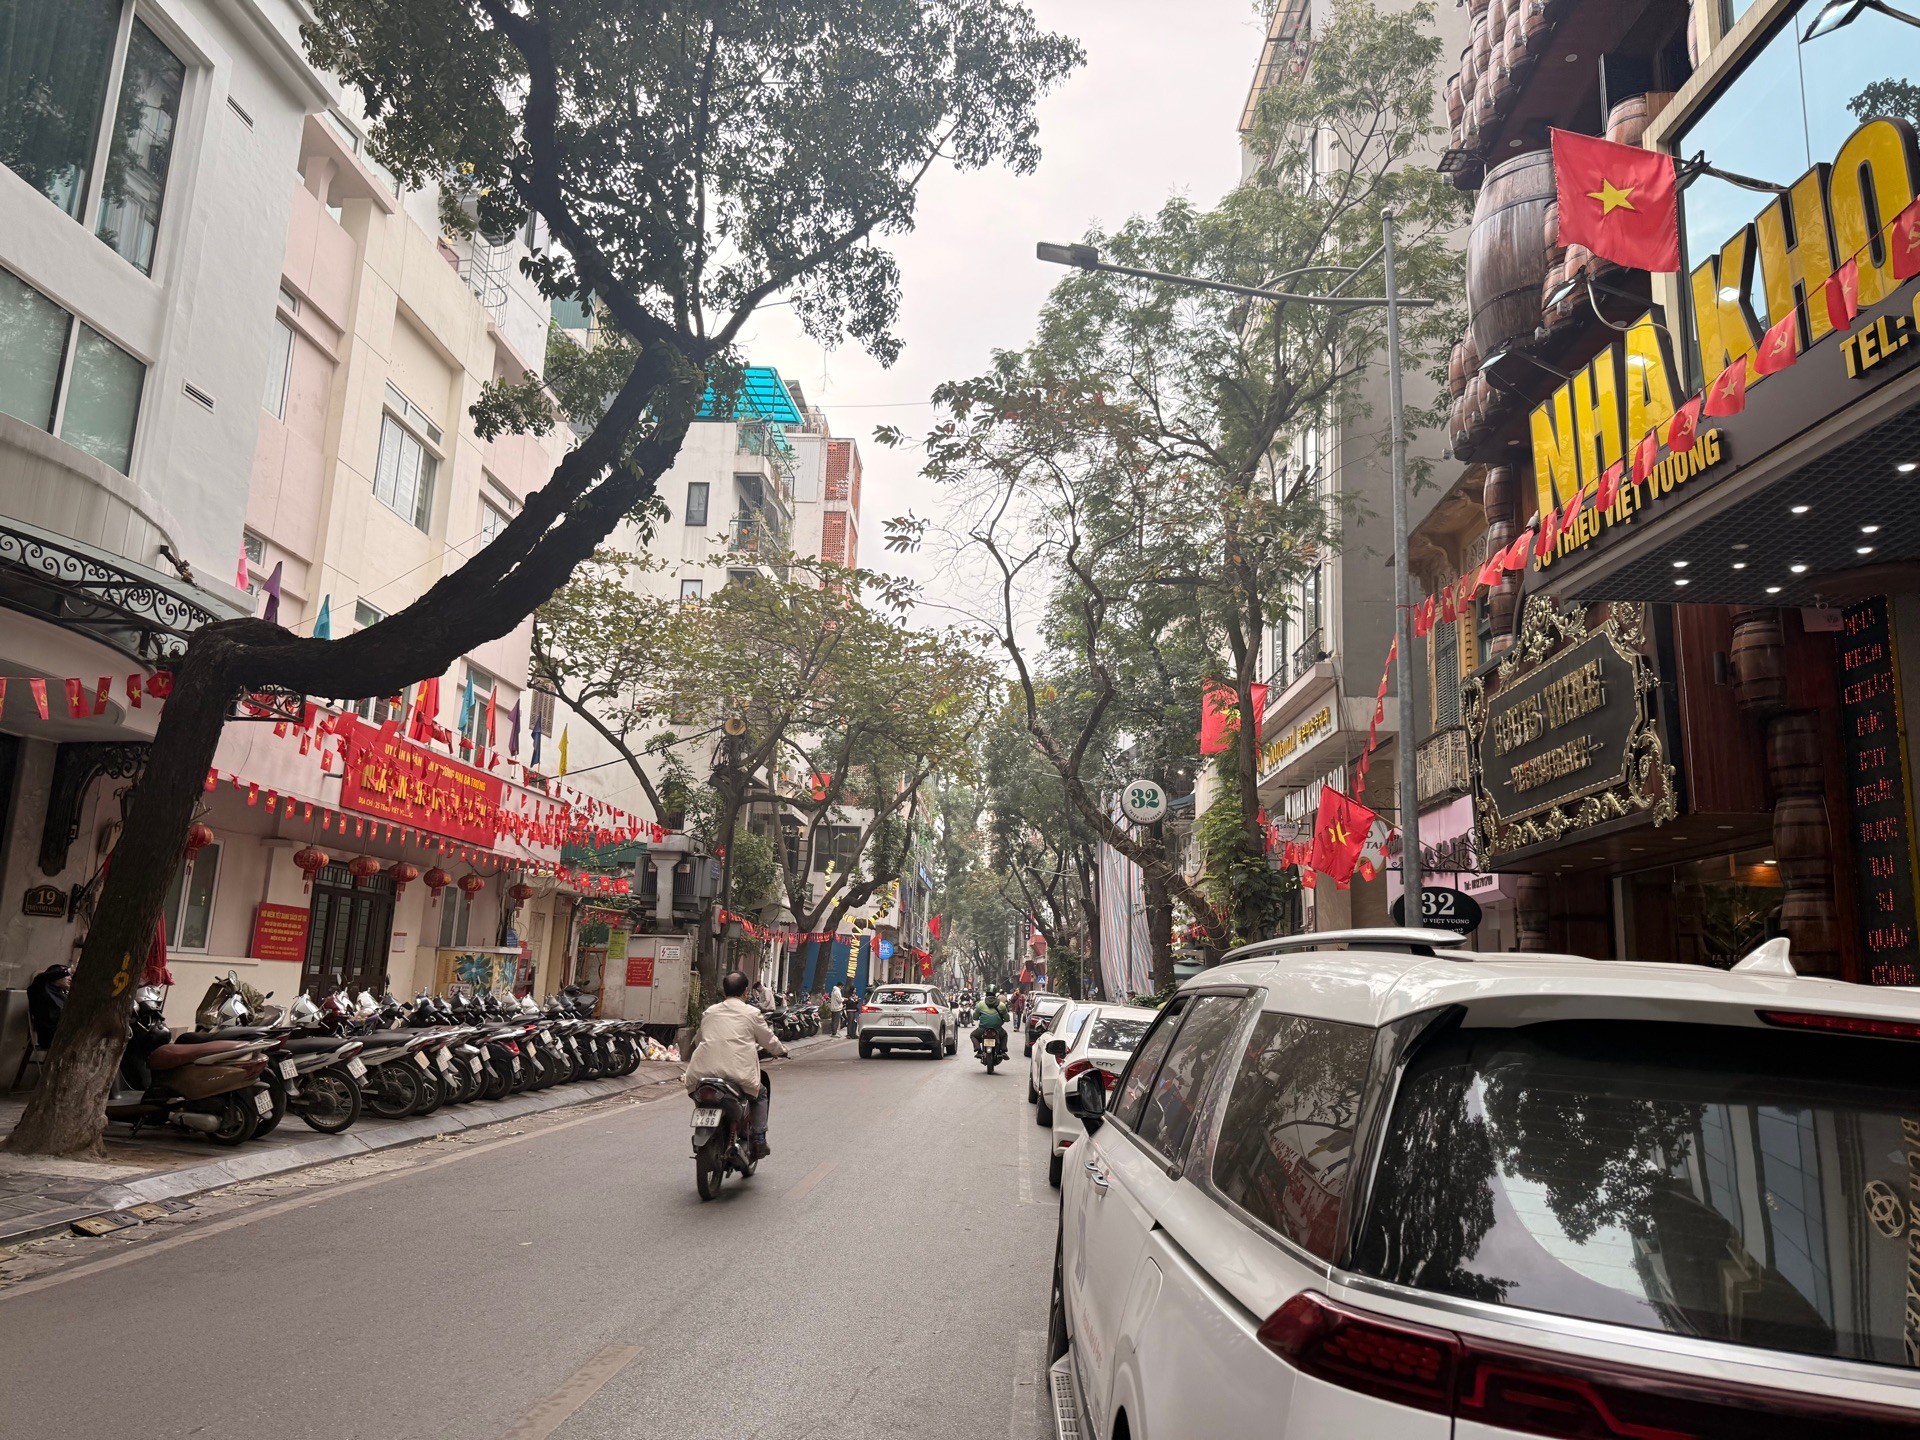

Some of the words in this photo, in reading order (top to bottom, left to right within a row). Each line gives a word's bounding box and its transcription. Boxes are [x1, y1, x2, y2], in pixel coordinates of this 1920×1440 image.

[1690, 119, 1913, 394] KHO
[1839, 315, 1909, 379] TEL:
[1604, 477, 1642, 526] VIỆT
[1131, 788, 1159, 809] 32
[1306, 775, 1326, 813] KHO
[37, 890, 56, 905] 19
[1422, 892, 1455, 916] 32
